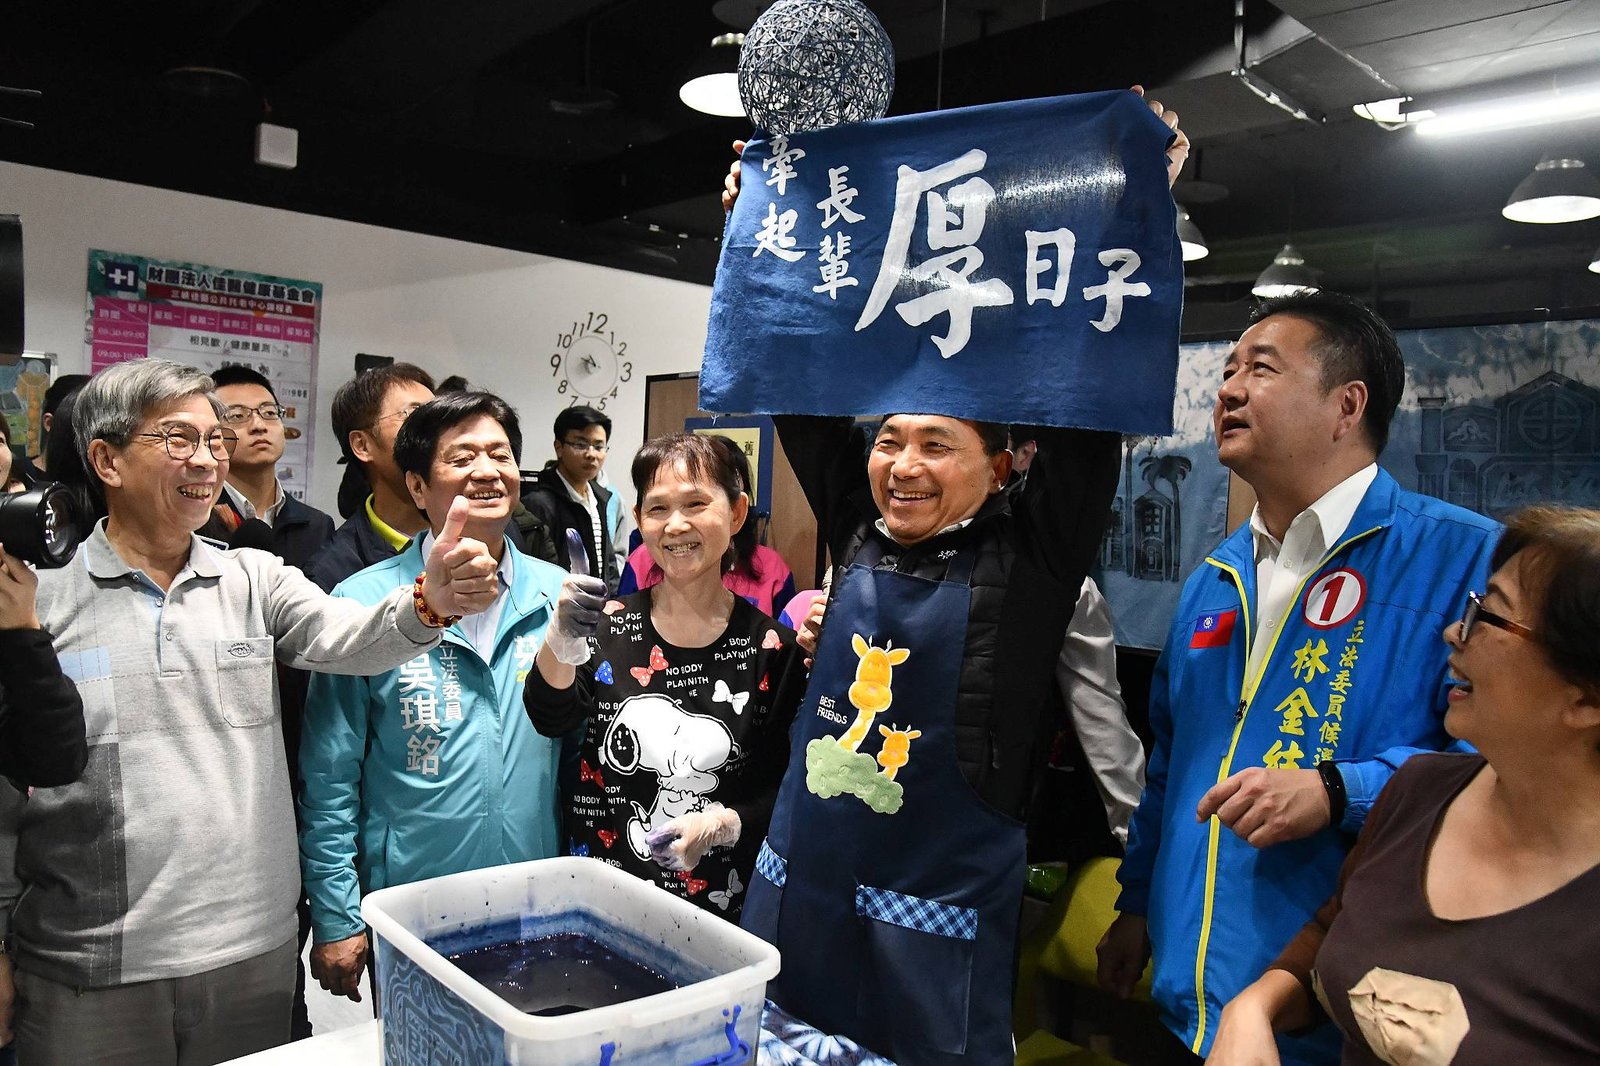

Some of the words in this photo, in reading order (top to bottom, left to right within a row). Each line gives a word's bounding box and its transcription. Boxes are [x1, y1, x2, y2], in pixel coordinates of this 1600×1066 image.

[572, 322, 585, 337] 11
[586, 311, 608, 334] 12
[556, 333, 573, 349] 10
[610, 331, 614, 345] 1
[617, 342, 627, 356] 2
[550, 354, 562, 377] 9
[620, 361, 633, 382] 3
[557, 379, 568, 394] 8
[609, 385, 618, 399] 4
[569, 395, 579, 408] 7
[597, 397, 608, 411] 5
[1319, 575, 1348, 622] 1
[610, 615, 624, 624] NO
[729, 636, 751, 646] BODY
[665, 667, 679, 676] NO
[439, 643, 465, 721] 立法委員
[598, 701, 611, 710] NO
[819, 695, 836, 709] BEST
[398, 652, 442, 776] 吳琪銘
[816, 706, 848, 725] FRIENDS
